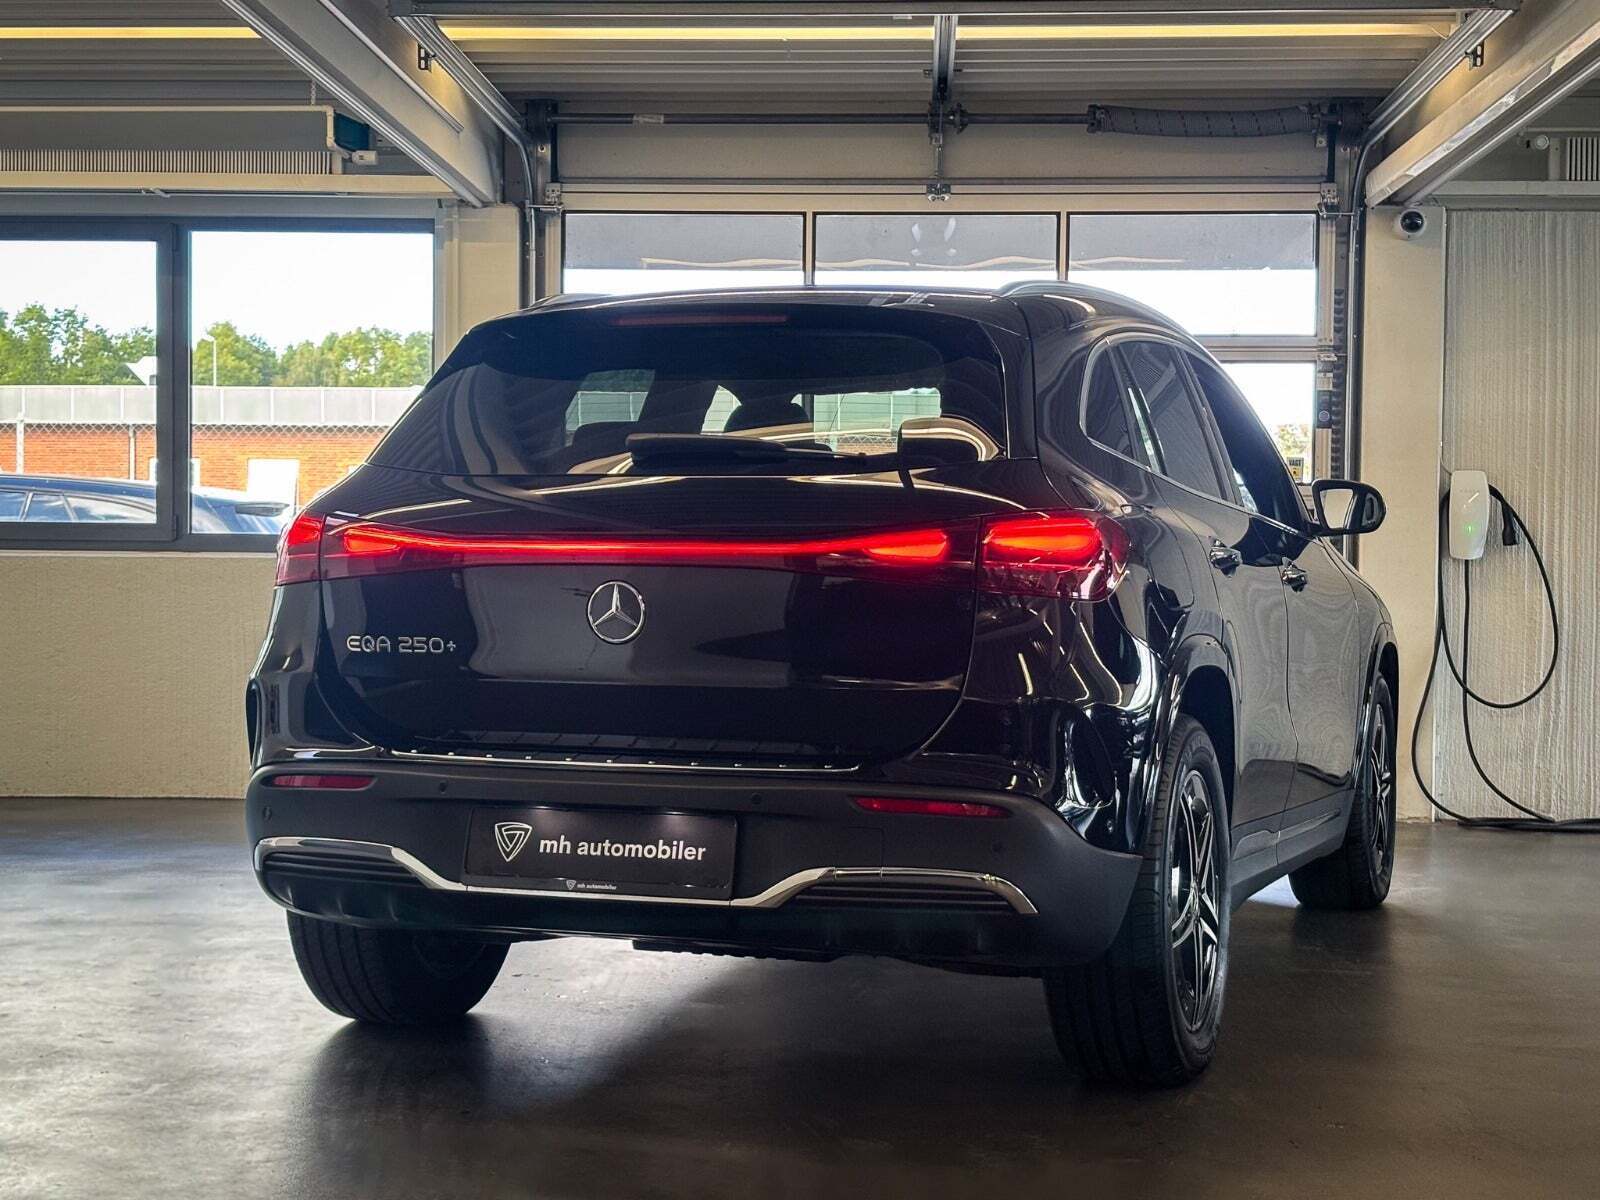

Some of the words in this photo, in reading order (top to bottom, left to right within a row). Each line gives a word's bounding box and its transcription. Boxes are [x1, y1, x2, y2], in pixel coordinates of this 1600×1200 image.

[347, 635, 391, 653] EQA
[398, 636, 456, 653] 250+
[539, 834, 571, 854] mh
[577, 839, 706, 861] automobiler
